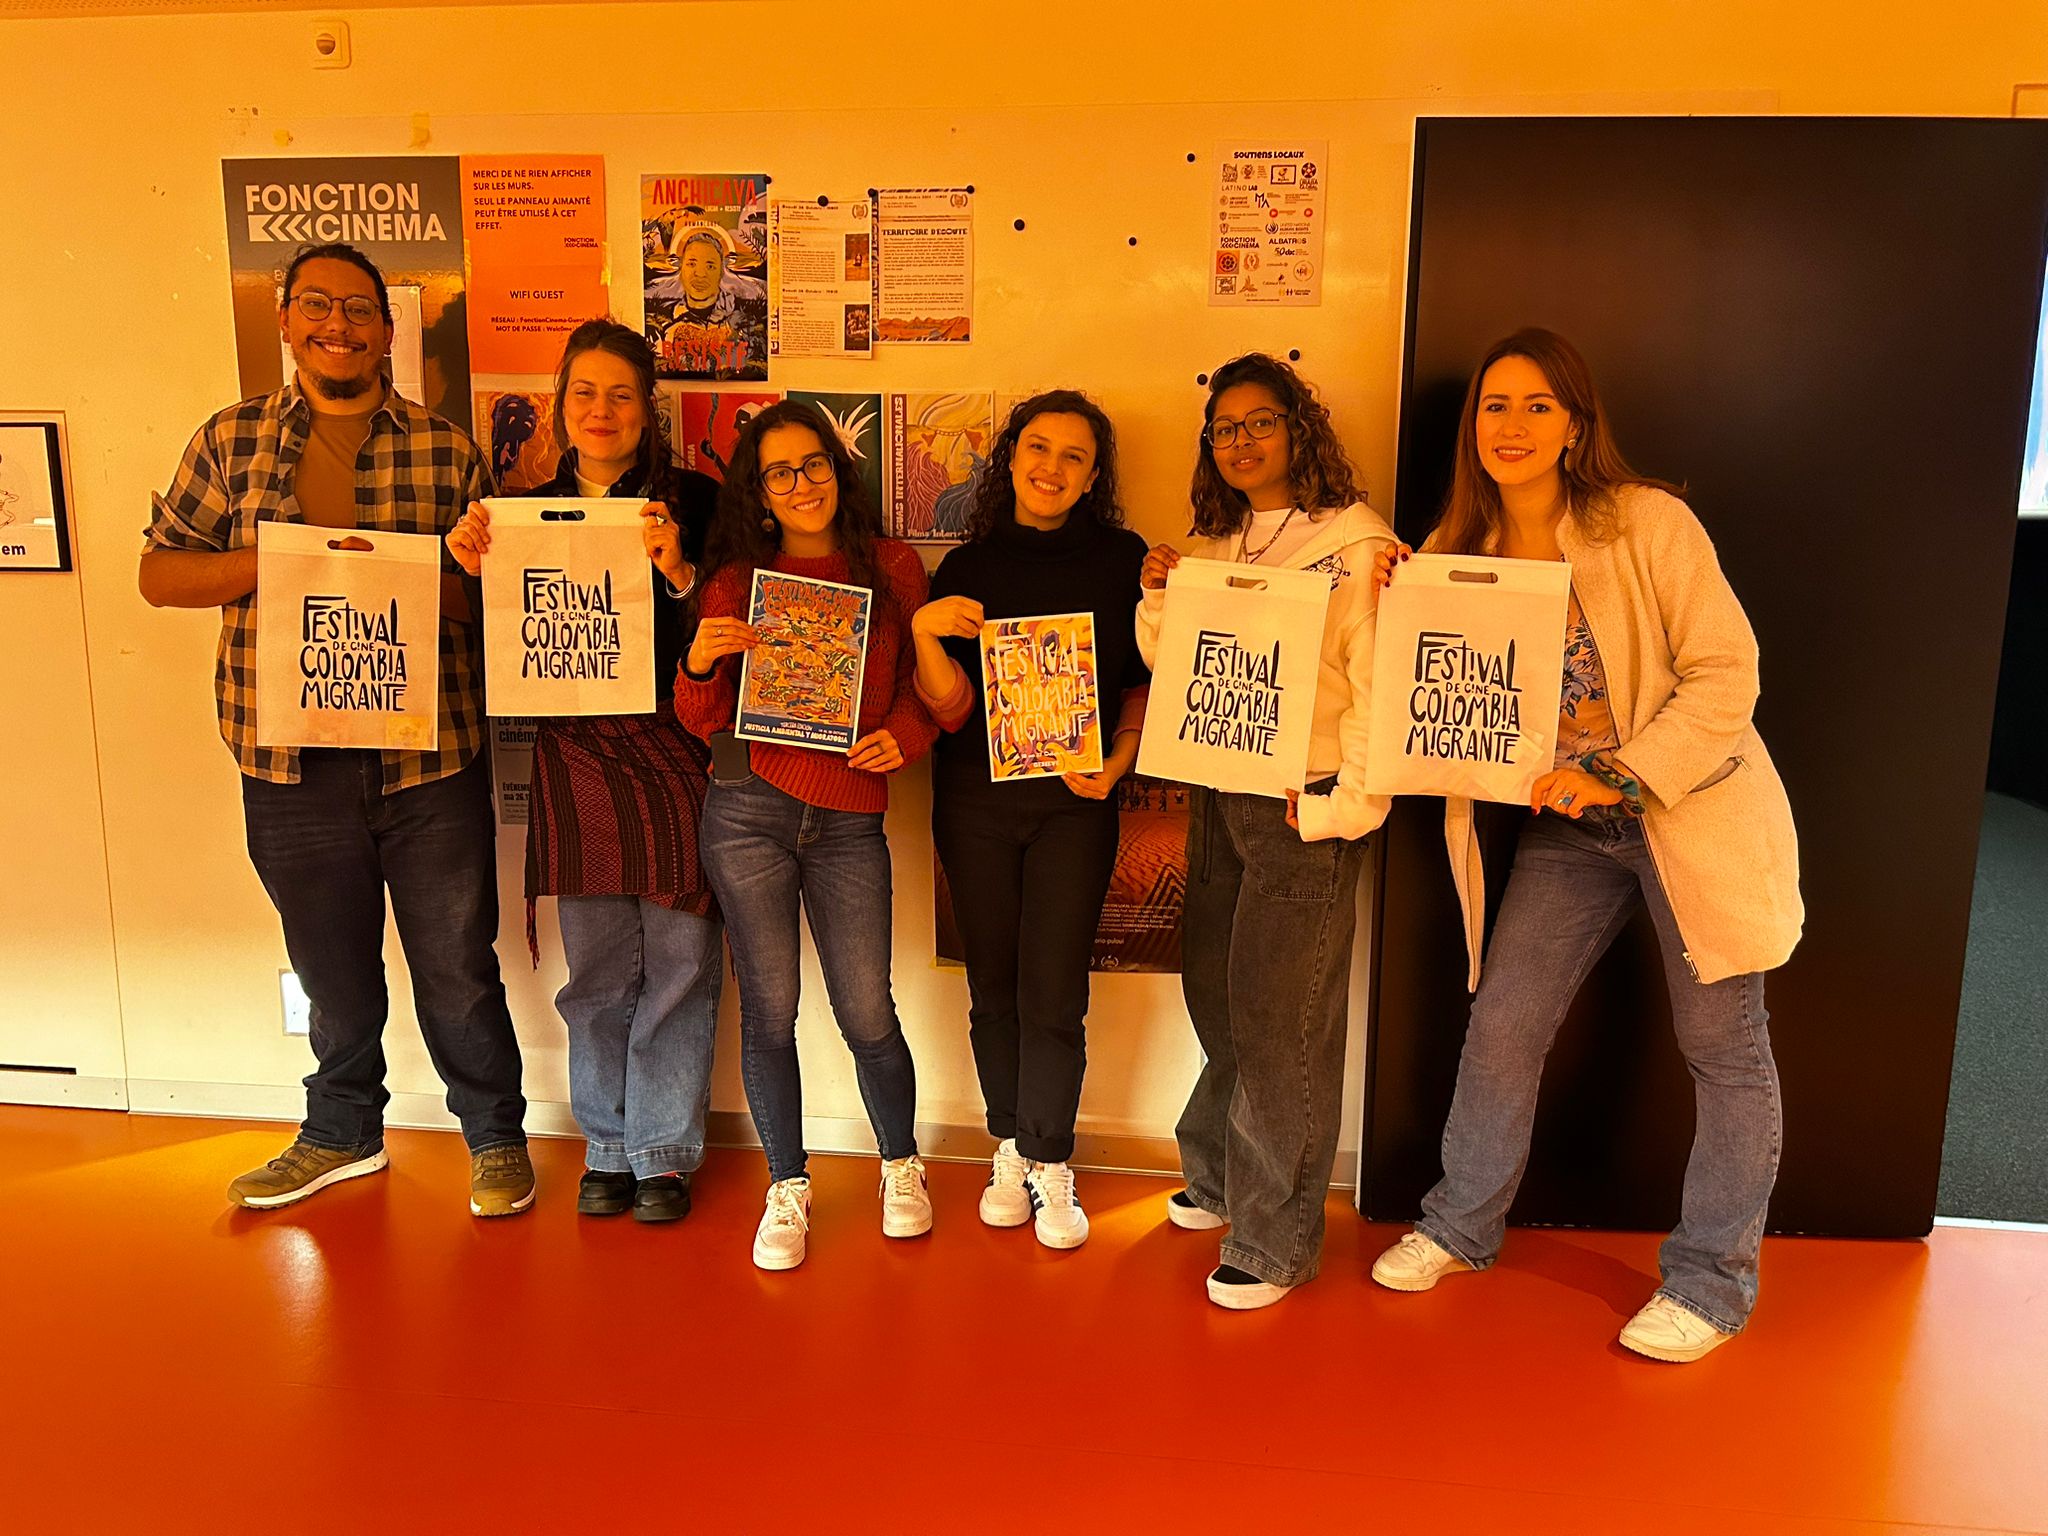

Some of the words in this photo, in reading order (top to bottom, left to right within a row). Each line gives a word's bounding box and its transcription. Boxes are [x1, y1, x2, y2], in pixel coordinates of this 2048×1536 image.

[473, 170, 499, 178] MERCI
[551, 169, 592, 177] AFFICHER
[508, 182, 534, 190] MURS.
[245, 182, 420, 213] FONCTION
[552, 196, 591, 205] AIMANTÉ
[498, 208, 517, 217] ÊTRE
[519, 208, 550, 217] UTILISÉ
[552, 208, 559, 217] À
[315, 213, 447, 242] CINEMA
[475, 222, 502, 230] EFFET.
[882, 228, 928, 236] TERRITOIRE
[509, 290, 531, 299] WIFI
[533, 290, 564, 299] GUEST
[491, 315, 515, 323] RÉSEAU
[552, 612, 565, 621] DE
[333, 641, 346, 651] DE
[1219, 678, 1230, 688] DE
[1446, 682, 1460, 693] DE
[744, 723, 770, 733] JUSTICIA
[499, 728, 537, 742] ciném
